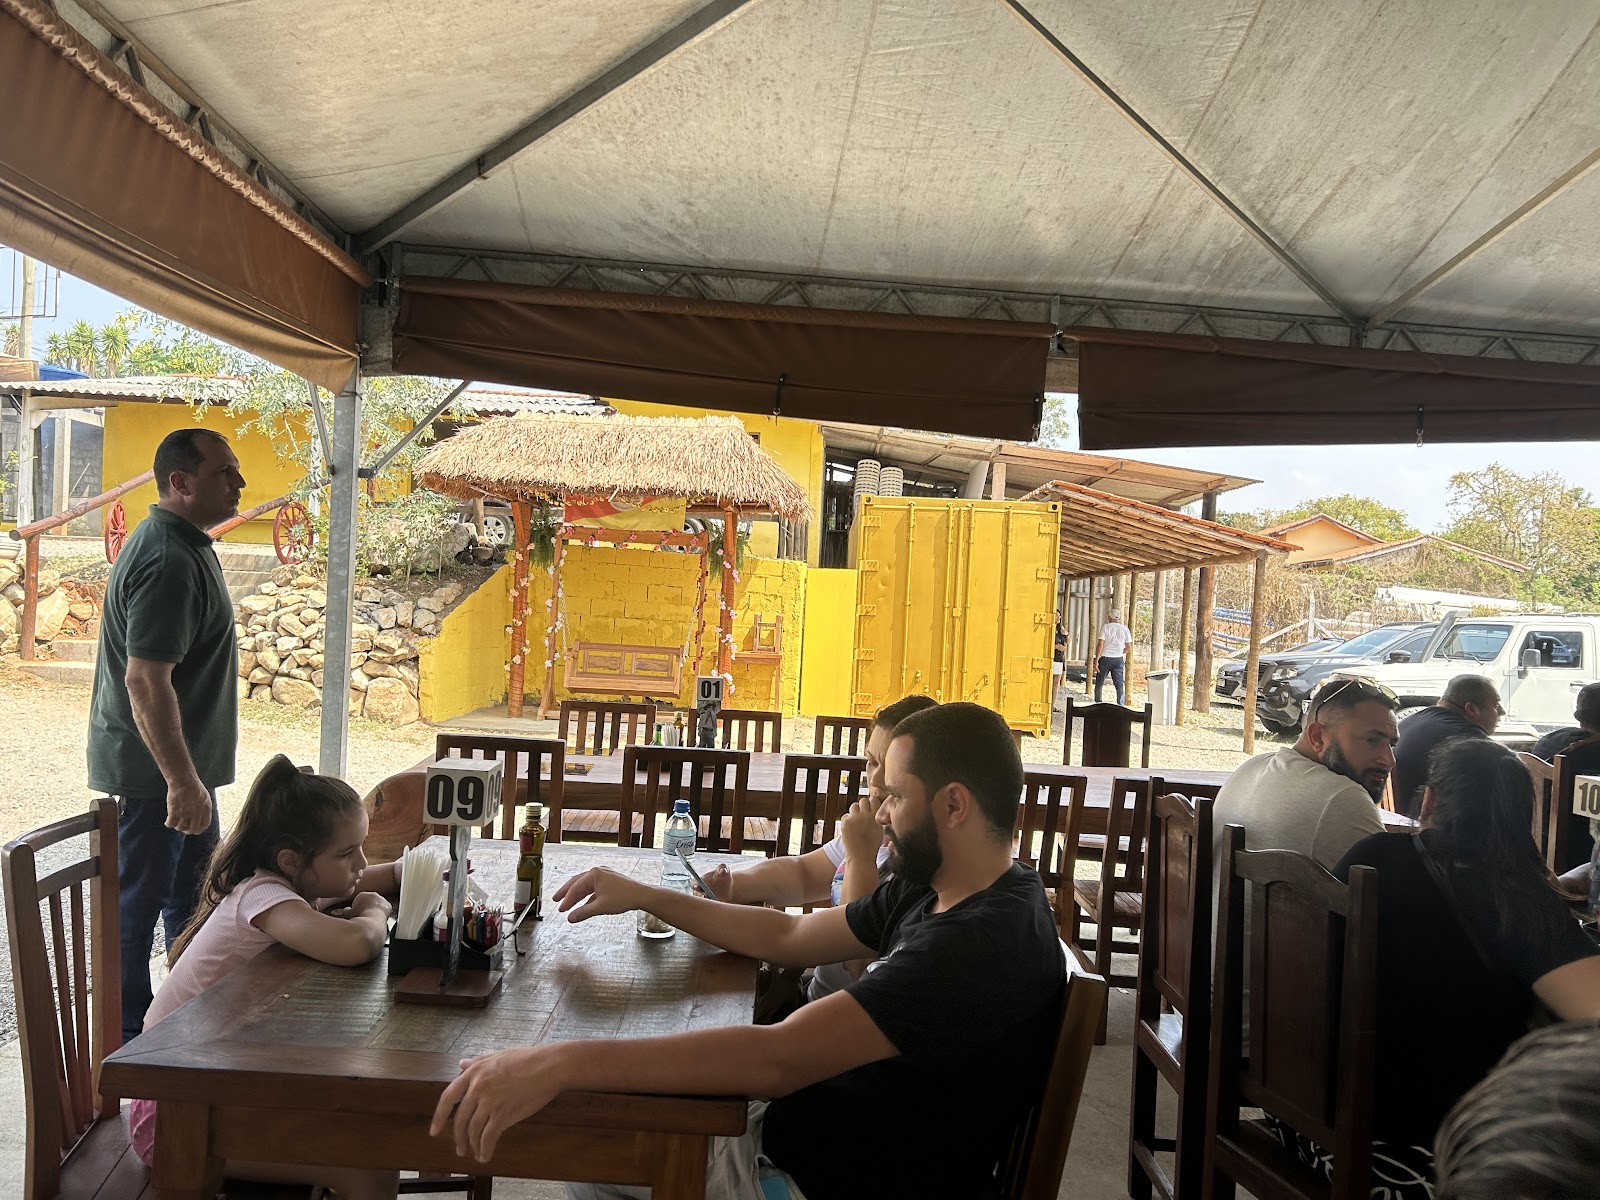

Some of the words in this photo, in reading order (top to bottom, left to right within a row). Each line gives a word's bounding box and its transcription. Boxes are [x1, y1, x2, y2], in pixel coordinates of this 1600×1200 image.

[701, 680, 720, 698] 01
[427, 774, 484, 820] 09
[486, 770, 502, 818] 09
[1578, 783, 1600, 815] 10
